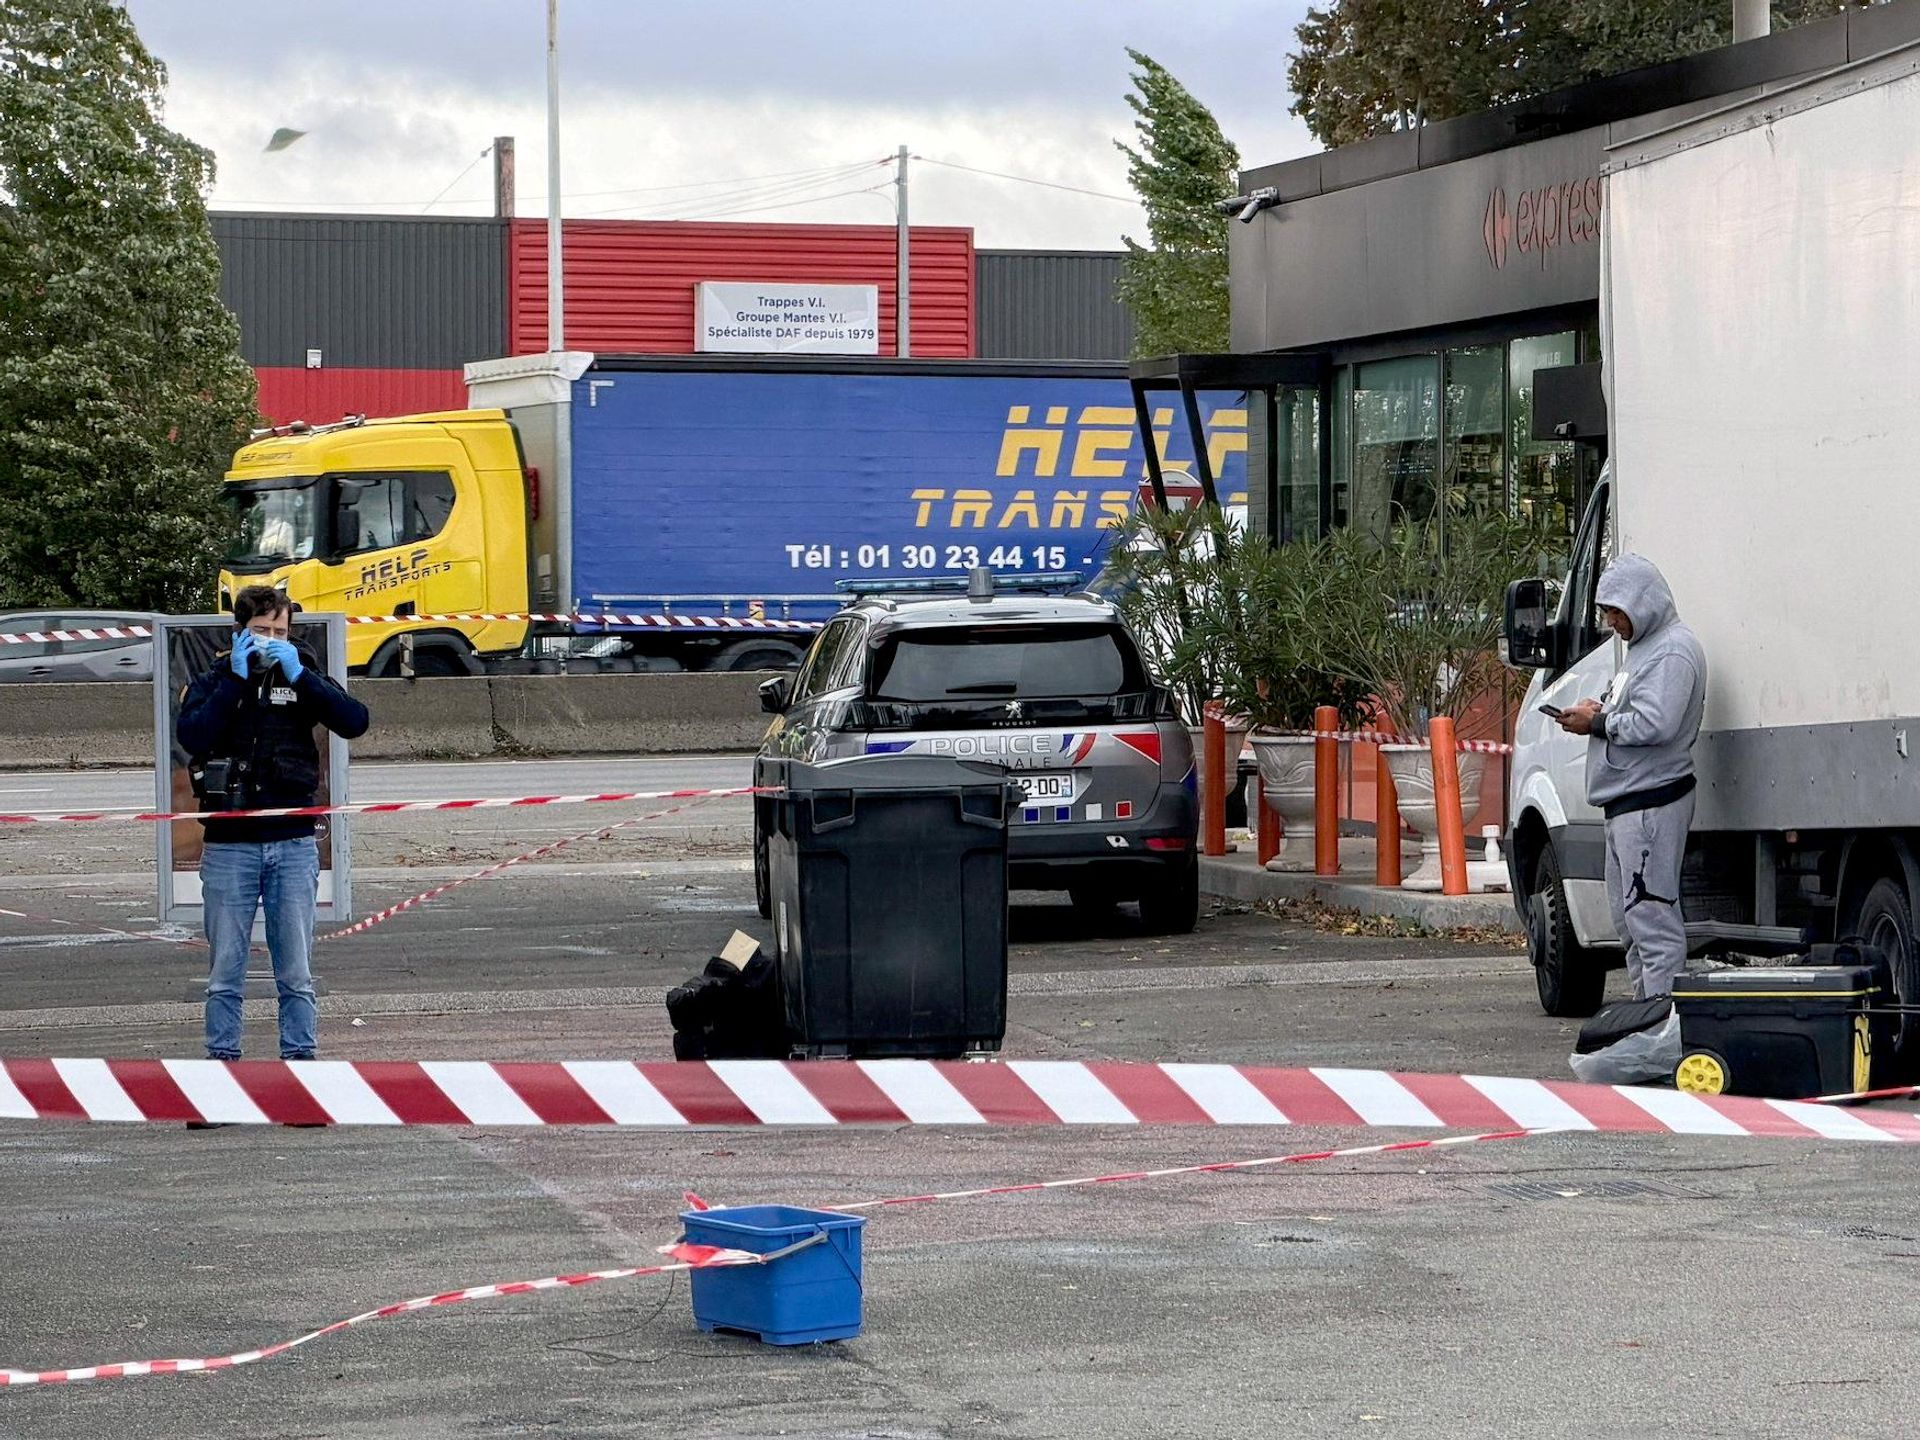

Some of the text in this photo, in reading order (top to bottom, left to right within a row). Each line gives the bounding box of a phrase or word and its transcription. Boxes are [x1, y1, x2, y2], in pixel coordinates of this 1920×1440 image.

[1516, 176, 1601, 271] expres
[757, 296, 825, 309] Trappes V.I.
[736, 311, 847, 324] Groupe Mantes V.I.
[708, 325, 874, 340] Spécialiste DAF depuis 1979
[361, 548, 429, 585] HELP
[785, 544, 831, 568] Tél
[858, 544, 890, 569] 01
[902, 545, 936, 569] 30
[944, 545, 980, 569] 23
[988, 545, 1023, 569] 44
[1032, 546, 1066, 569] 15
[344, 560, 452, 601] TRANSPORTS
[929, 735, 1051, 756] POLICE
